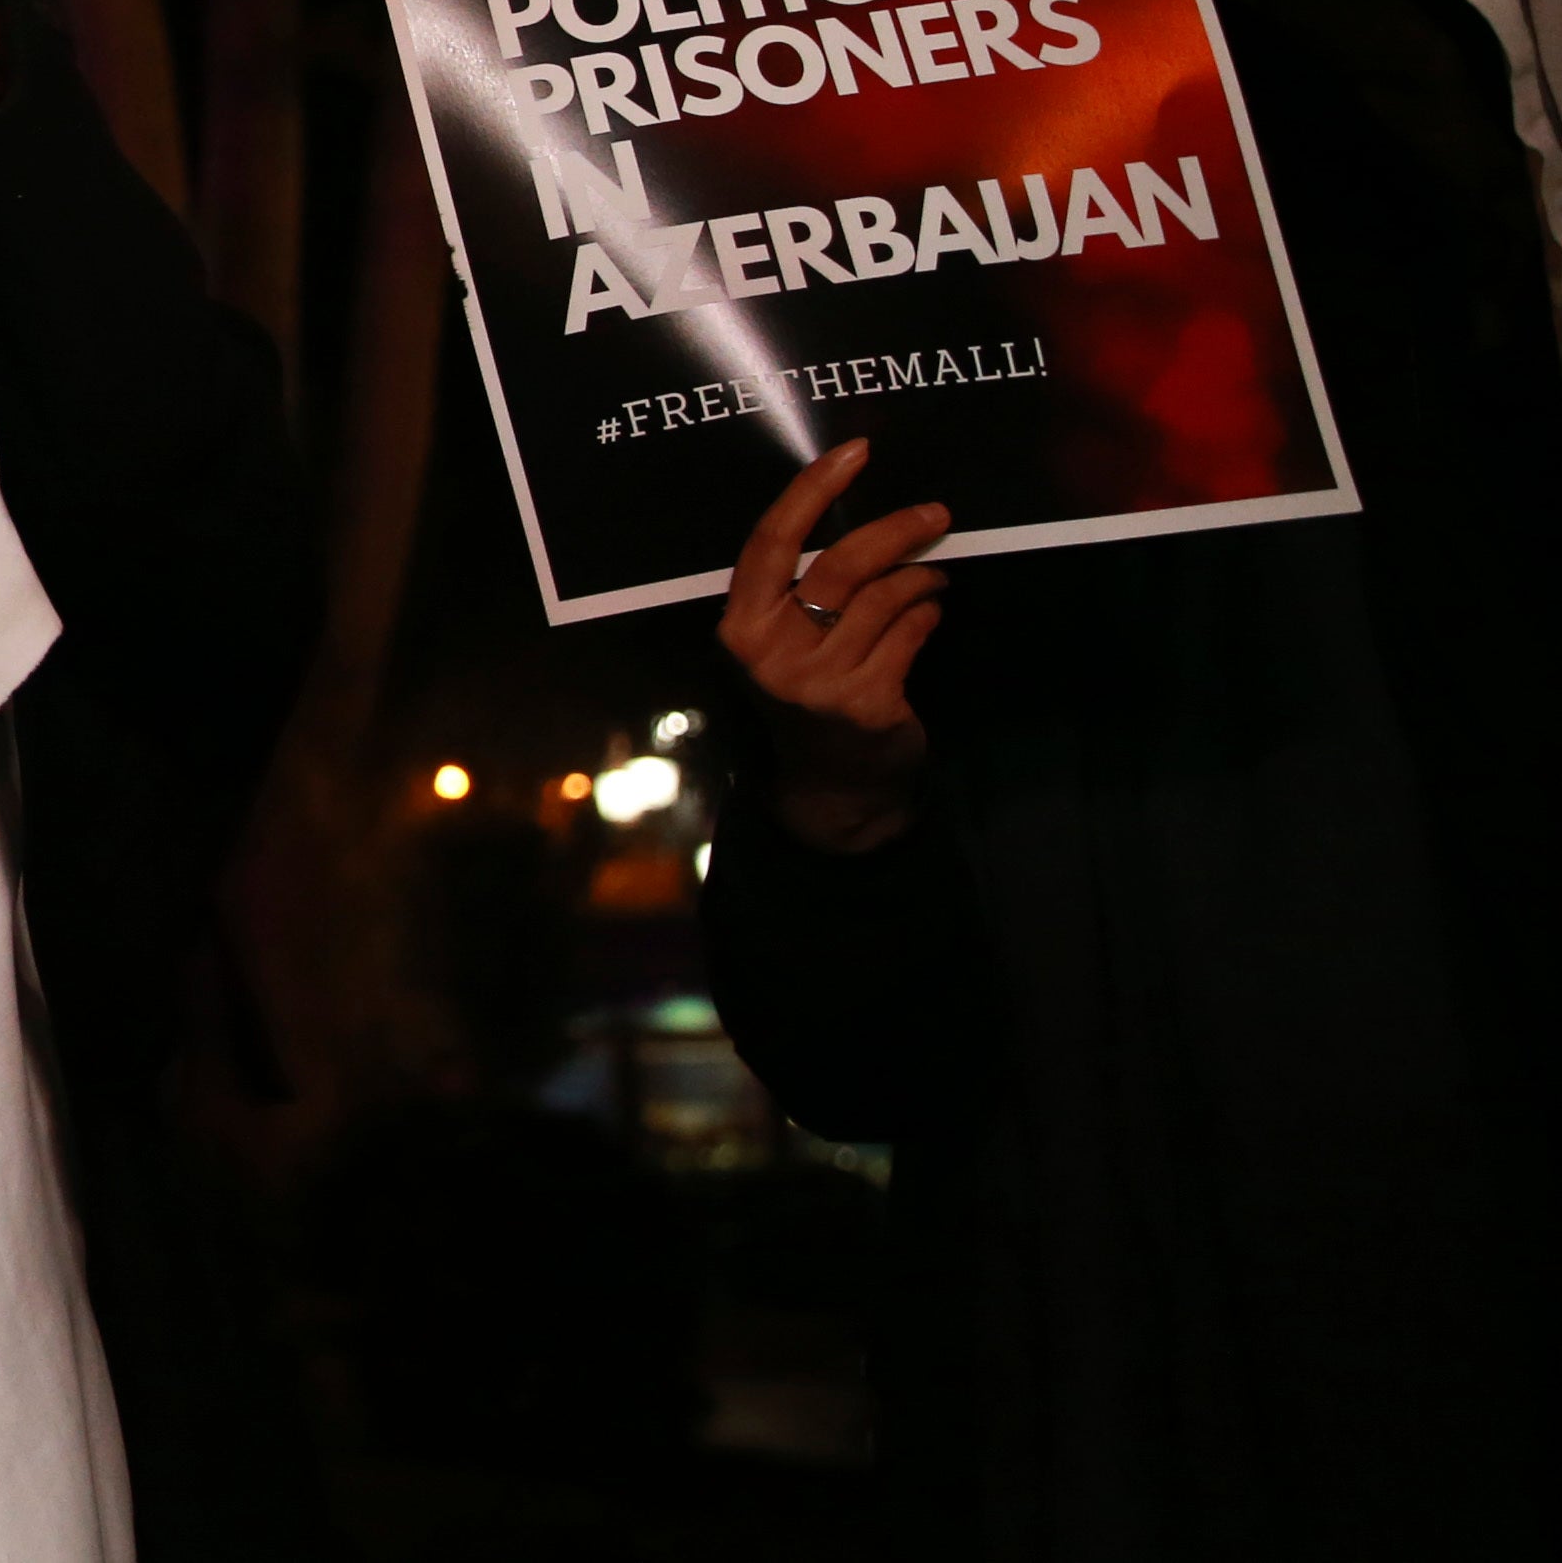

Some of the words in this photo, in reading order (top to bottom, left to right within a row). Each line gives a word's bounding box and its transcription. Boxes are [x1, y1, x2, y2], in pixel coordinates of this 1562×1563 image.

[528, 140, 650, 240] IN
[563, 156, 1220, 336] AZERBAIJAN
[595, 338, 1049, 444] #FREETHEMALL!
